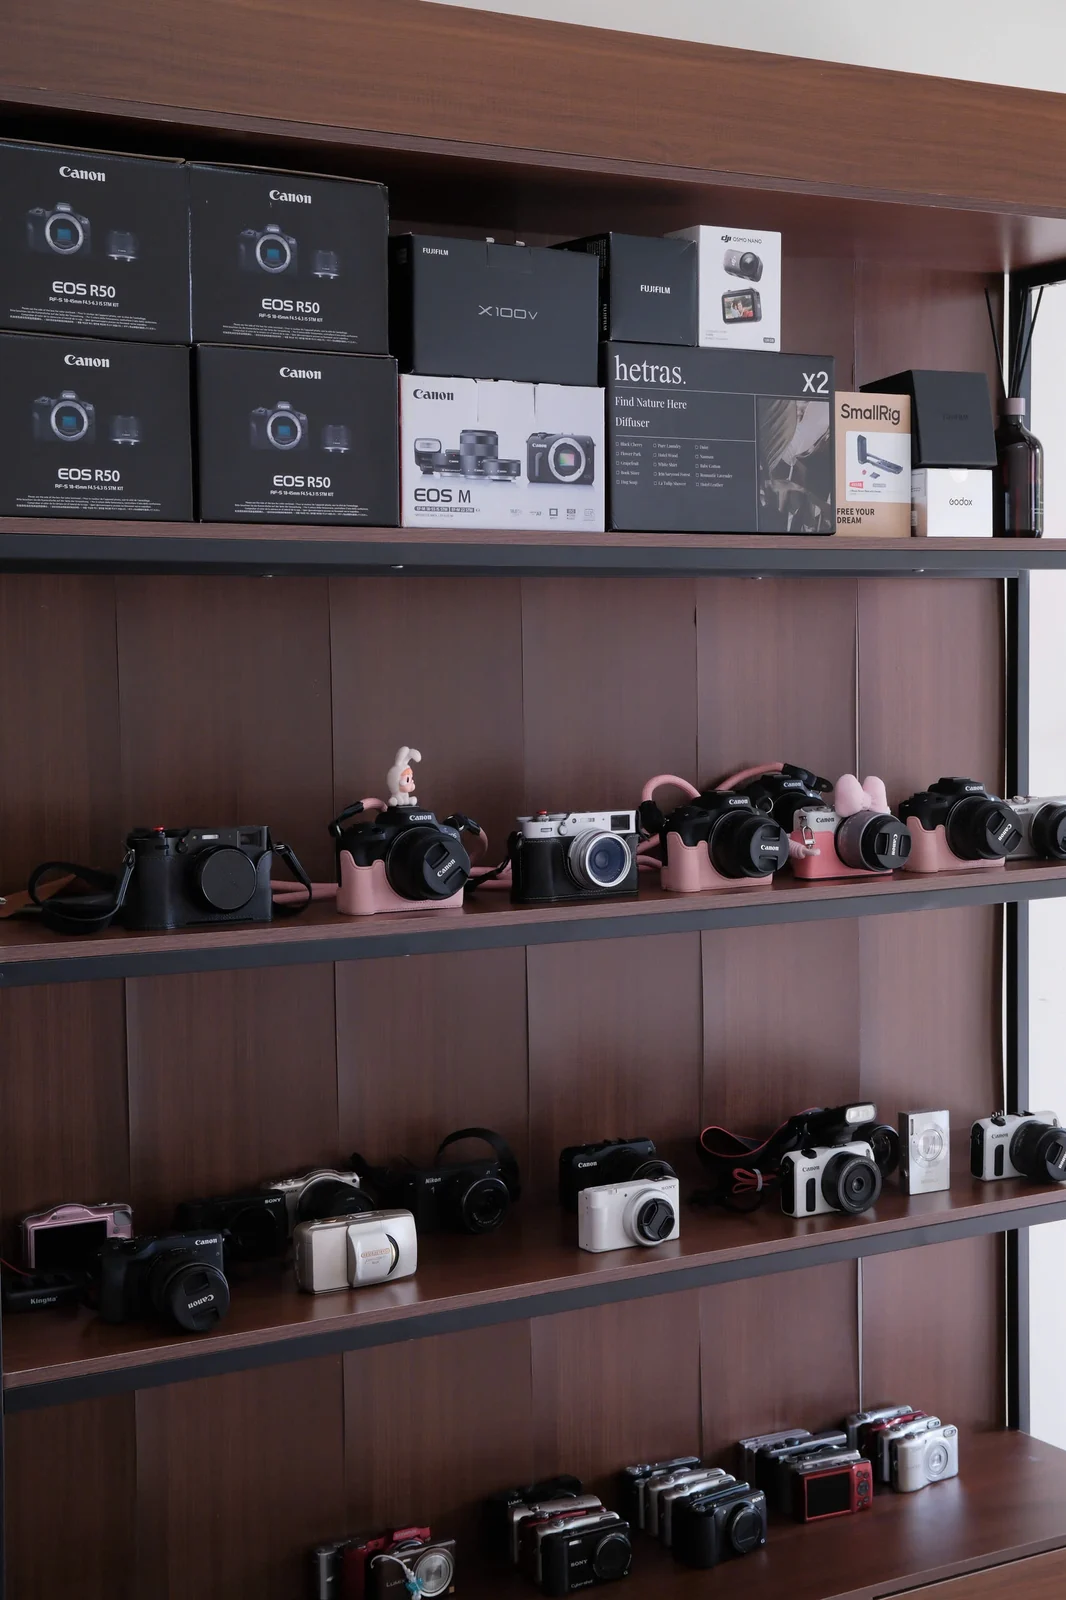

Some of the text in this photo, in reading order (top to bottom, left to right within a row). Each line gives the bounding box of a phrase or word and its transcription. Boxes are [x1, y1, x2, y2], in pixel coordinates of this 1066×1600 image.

[59, 166, 106, 182] Canon
[269, 189, 312, 204] Canon
[422, 247, 449, 256] FUJIFILM
[52, 281, 116, 298] EOS R50
[640, 284, 671, 294] FUJIFILM
[261, 298, 320, 314] EOS R50
[478, 305, 538, 320] X100V
[64, 354, 110, 368] Canon
[279, 366, 322, 380] Canon
[614, 354, 687, 385] hetras.
[802, 371, 829, 394] X2
[413, 388, 454, 401] Canon
[615, 396, 688, 409] Find Nature Here
[840, 403, 901, 426] SmallRig
[615, 417, 650, 428] Diffuser
[58, 468, 120, 482] EOS R50
[273, 475, 331, 488] EOS R50
[414, 488, 471, 503] EOS M
[949, 497, 973, 506] Godox
[836, 508, 875, 516] FREE YOUR
[836, 516, 862, 524] DREAM
[409, 813, 432, 821] Canon
[998, 823, 1013, 841] Canon
[891, 833, 899, 856] Canon
[436, 858, 456, 877] Canon
[578, 1160, 598, 1168] Canon
[802, 1165, 820, 1173] Canon
[425, 1177, 441, 1185] Nikon
[195, 1238, 218, 1246] Canon
[187, 1294, 215, 1310] Canon
[752, 1495, 765, 1503] SONY
[570, 1559, 588, 1568] SONY
